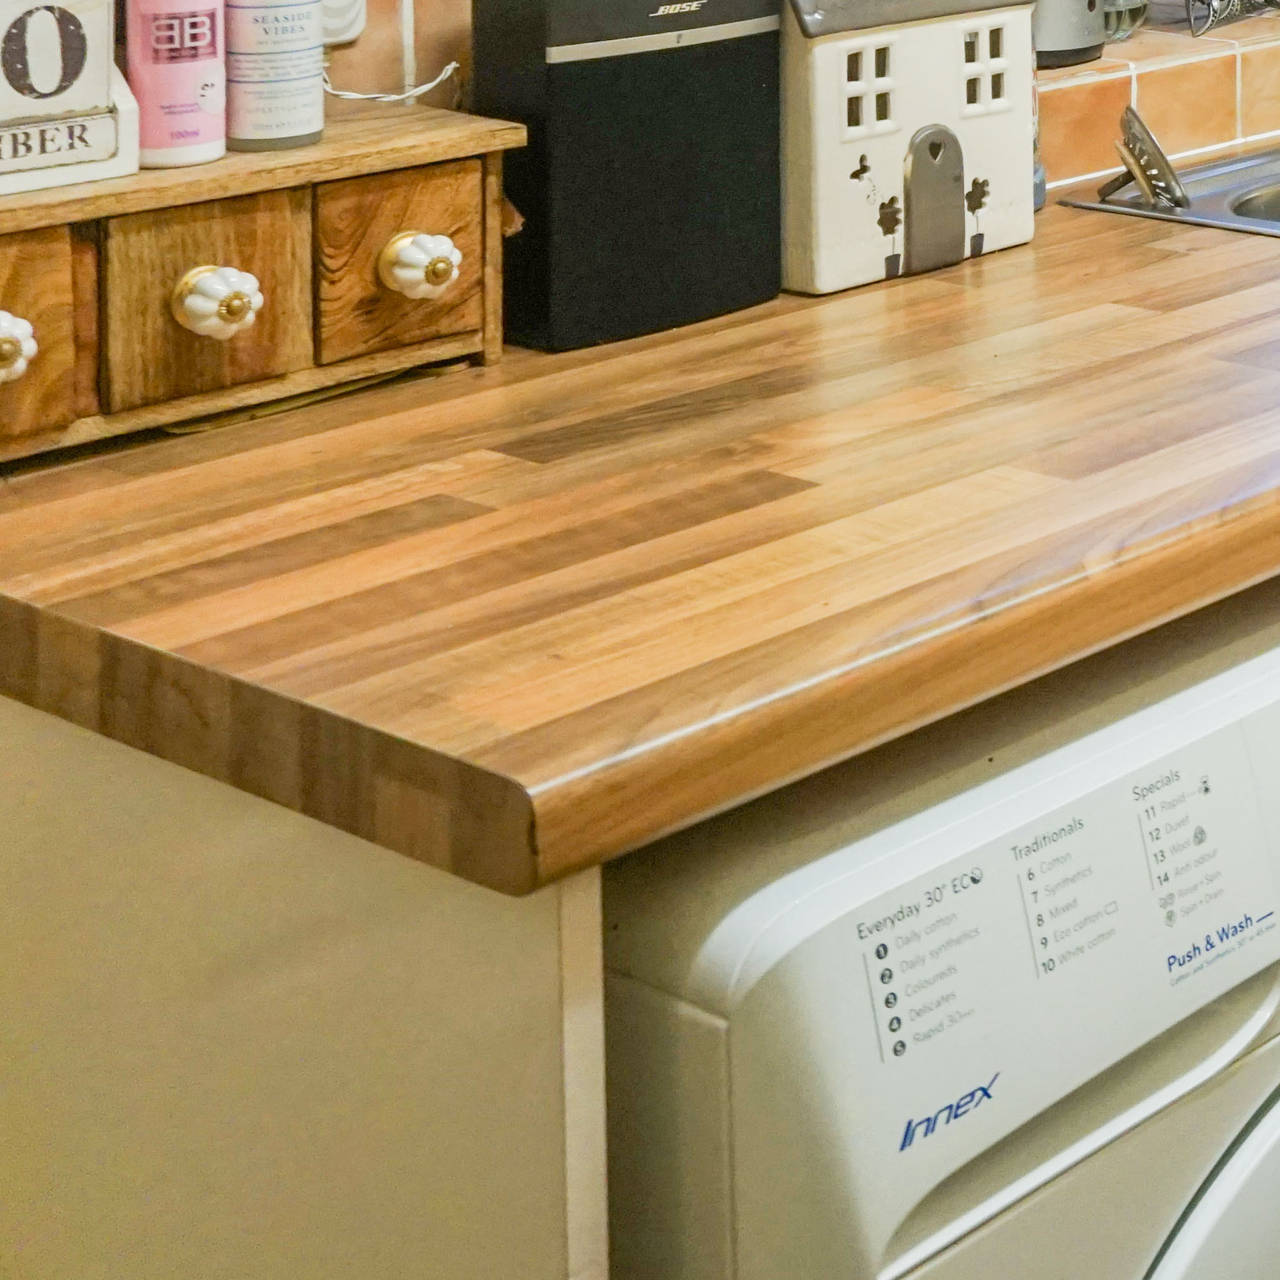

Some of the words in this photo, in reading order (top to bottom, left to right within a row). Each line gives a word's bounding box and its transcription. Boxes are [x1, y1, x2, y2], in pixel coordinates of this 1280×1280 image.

[648, 0, 709, 17] BOSE
[252, 11, 313, 25] SEASIDE
[262, 25, 306, 37] VIBES
[1132, 769, 1182, 803] Specials
[1145, 805, 1157, 820] 11
[1010, 817, 1085, 861] Traditionals
[1149, 827, 1162, 842] 12
[1153, 849, 1166, 864] 13
[1027, 867, 1036, 881] 6
[1157, 872, 1170, 886] 14
[1031, 890, 1039, 904] 7
[856, 901, 921, 940] Everyday
[1037, 914, 1045, 927] 8
[1040, 936, 1048, 949] 9
[1167, 942, 1201, 972] Push
[1204, 934, 1216, 952] &
[1216, 913, 1254, 944] Wash
[1042, 957, 1056, 974] 10
[899, 1071, 1001, 1151] Innex
